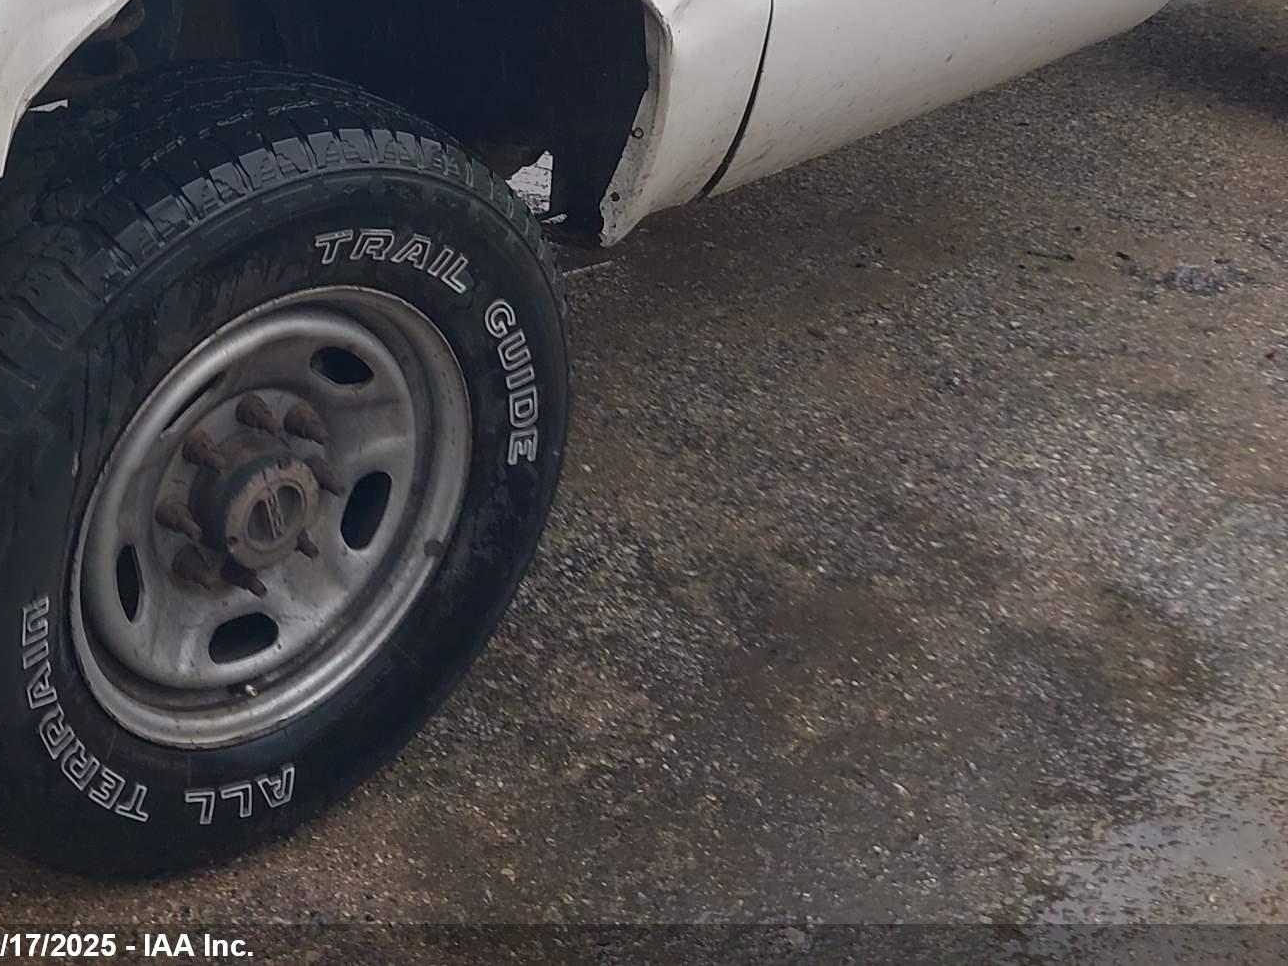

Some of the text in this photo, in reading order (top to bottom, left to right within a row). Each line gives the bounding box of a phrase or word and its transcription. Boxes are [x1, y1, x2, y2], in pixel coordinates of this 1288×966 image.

[315, 228, 540, 466] TRAIL GUIDE
[21, 596, 296, 825] ALL TERRAIN
